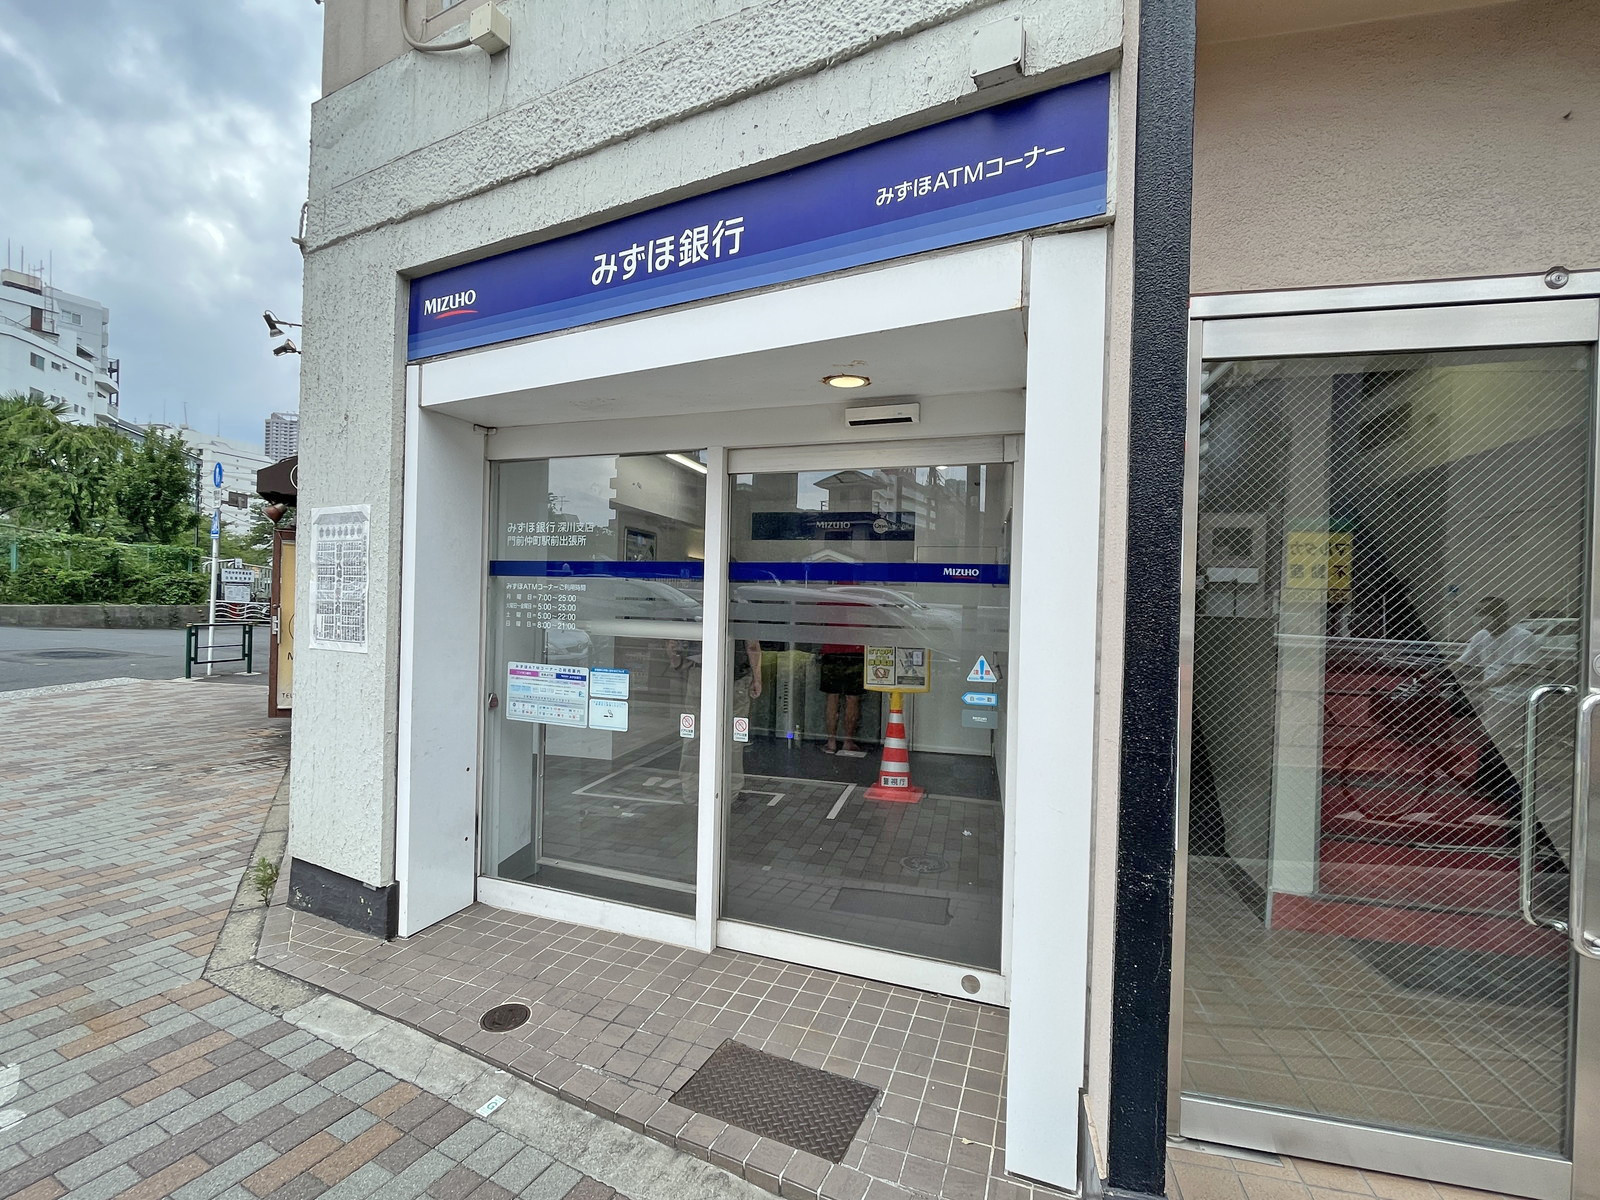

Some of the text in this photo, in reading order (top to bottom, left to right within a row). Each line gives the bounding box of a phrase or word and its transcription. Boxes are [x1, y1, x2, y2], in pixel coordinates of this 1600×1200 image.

[875, 145, 1066, 207] みずほATMコーナー
[591, 216, 746, 287] みずほ銀行
[423, 289, 477, 317] MIZUHO
[507, 521, 594, 533] みずほ銀行 深川支店
[507, 534, 587, 547] 門前仲町駅前出張所
[942, 567, 980, 577] MIZUHO
